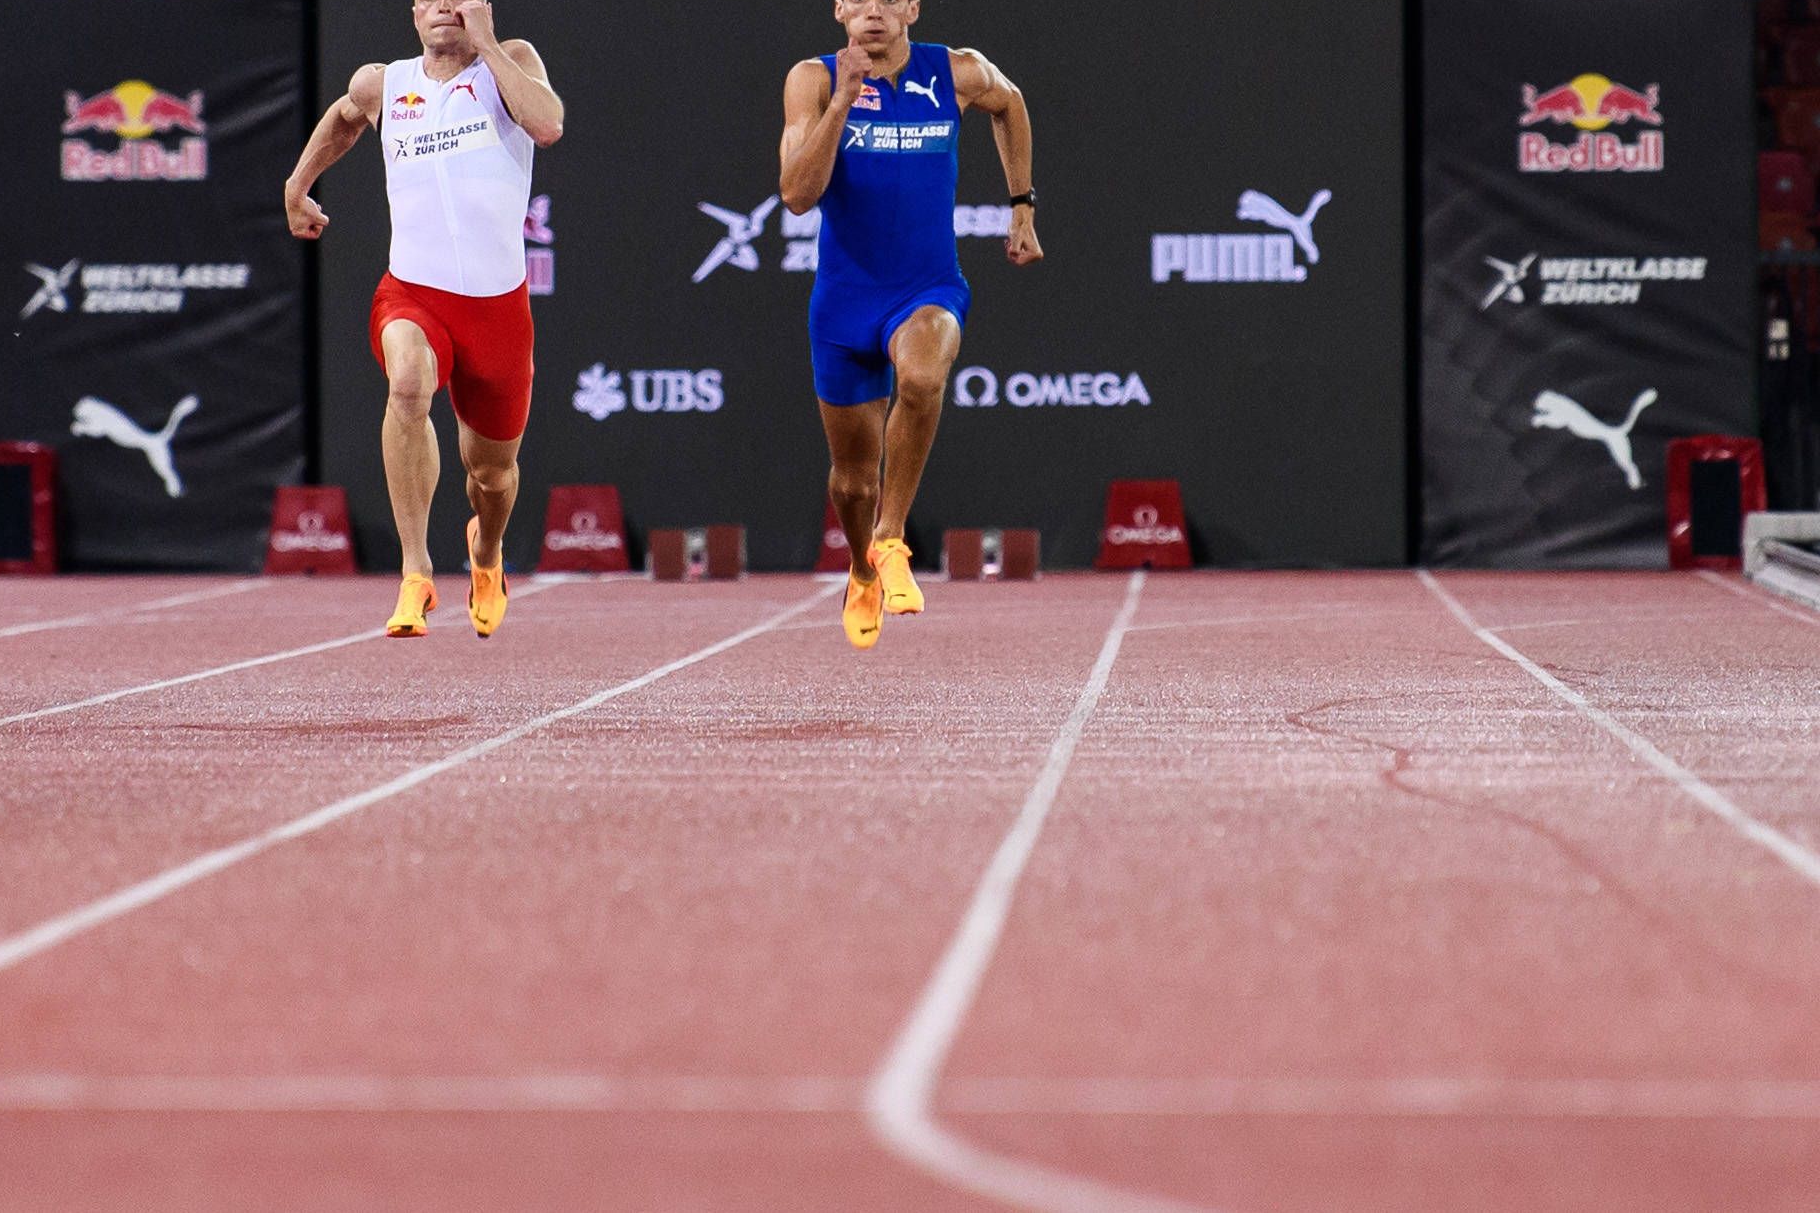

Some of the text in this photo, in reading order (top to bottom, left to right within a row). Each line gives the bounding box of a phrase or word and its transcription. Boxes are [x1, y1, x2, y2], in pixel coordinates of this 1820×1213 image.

[413, 121, 488, 144] WELTKLASSE
[873, 125, 950, 138] WELTKLASSE
[873, 137, 923, 149] ZÜRICH
[60, 138, 209, 181] Red Bull
[414, 139, 459, 156] ZÜRICH
[1518, 130, 1665, 172] Red Bull
[1151, 233, 1300, 282] PUMA
[1538, 257, 1708, 281] WELTKLASSE
[81, 263, 249, 288] WELTKLASSE
[1540, 280, 1642, 304] ZÜRICH
[627, 368, 725, 413] UBS
[1005, 371, 1152, 407] OMEGA
[1107, 524, 1182, 546] OMEGA
